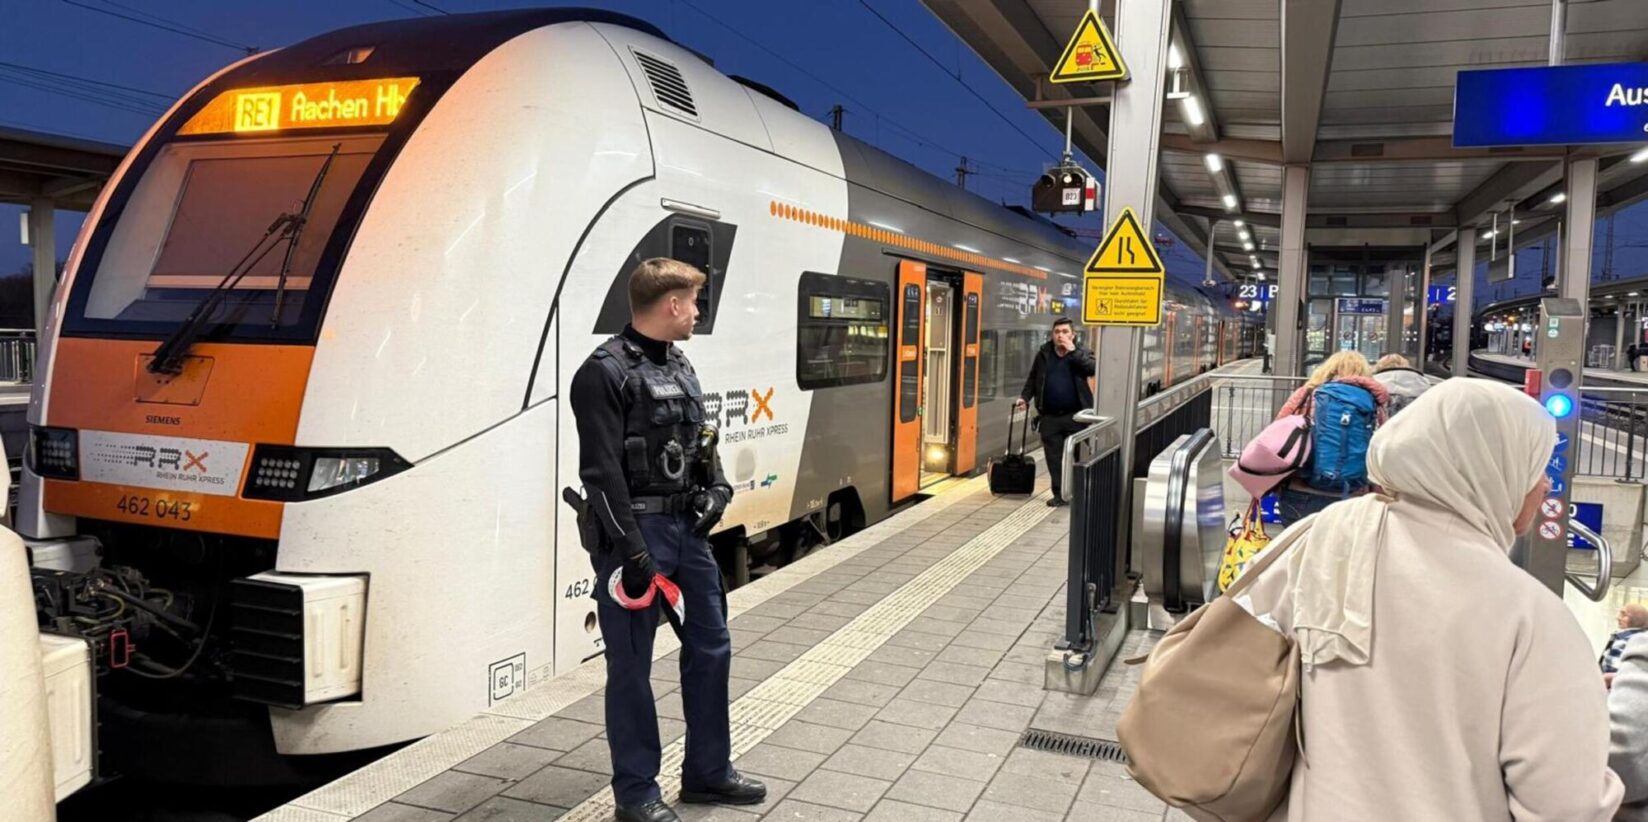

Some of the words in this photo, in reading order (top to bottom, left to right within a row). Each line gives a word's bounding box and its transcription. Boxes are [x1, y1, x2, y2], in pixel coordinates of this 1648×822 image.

[237, 95, 277, 128] RE1
[291, 89, 367, 121] Aachen
[376, 84, 406, 116] Hb
[1239, 284, 1258, 298] 23
[145, 415, 181, 425] SIEMENS
[725, 432, 746, 444] RHEIN
[748, 429, 766, 441] RUHR
[767, 423, 789, 436] XPRESS
[156, 471, 178, 481] RHEIN
[178, 473, 197, 483] RUHR
[199, 475, 225, 485] XPRESS
[117, 495, 149, 516] 462
[155, 499, 192, 521] 043
[565, 578, 590, 600] 462
